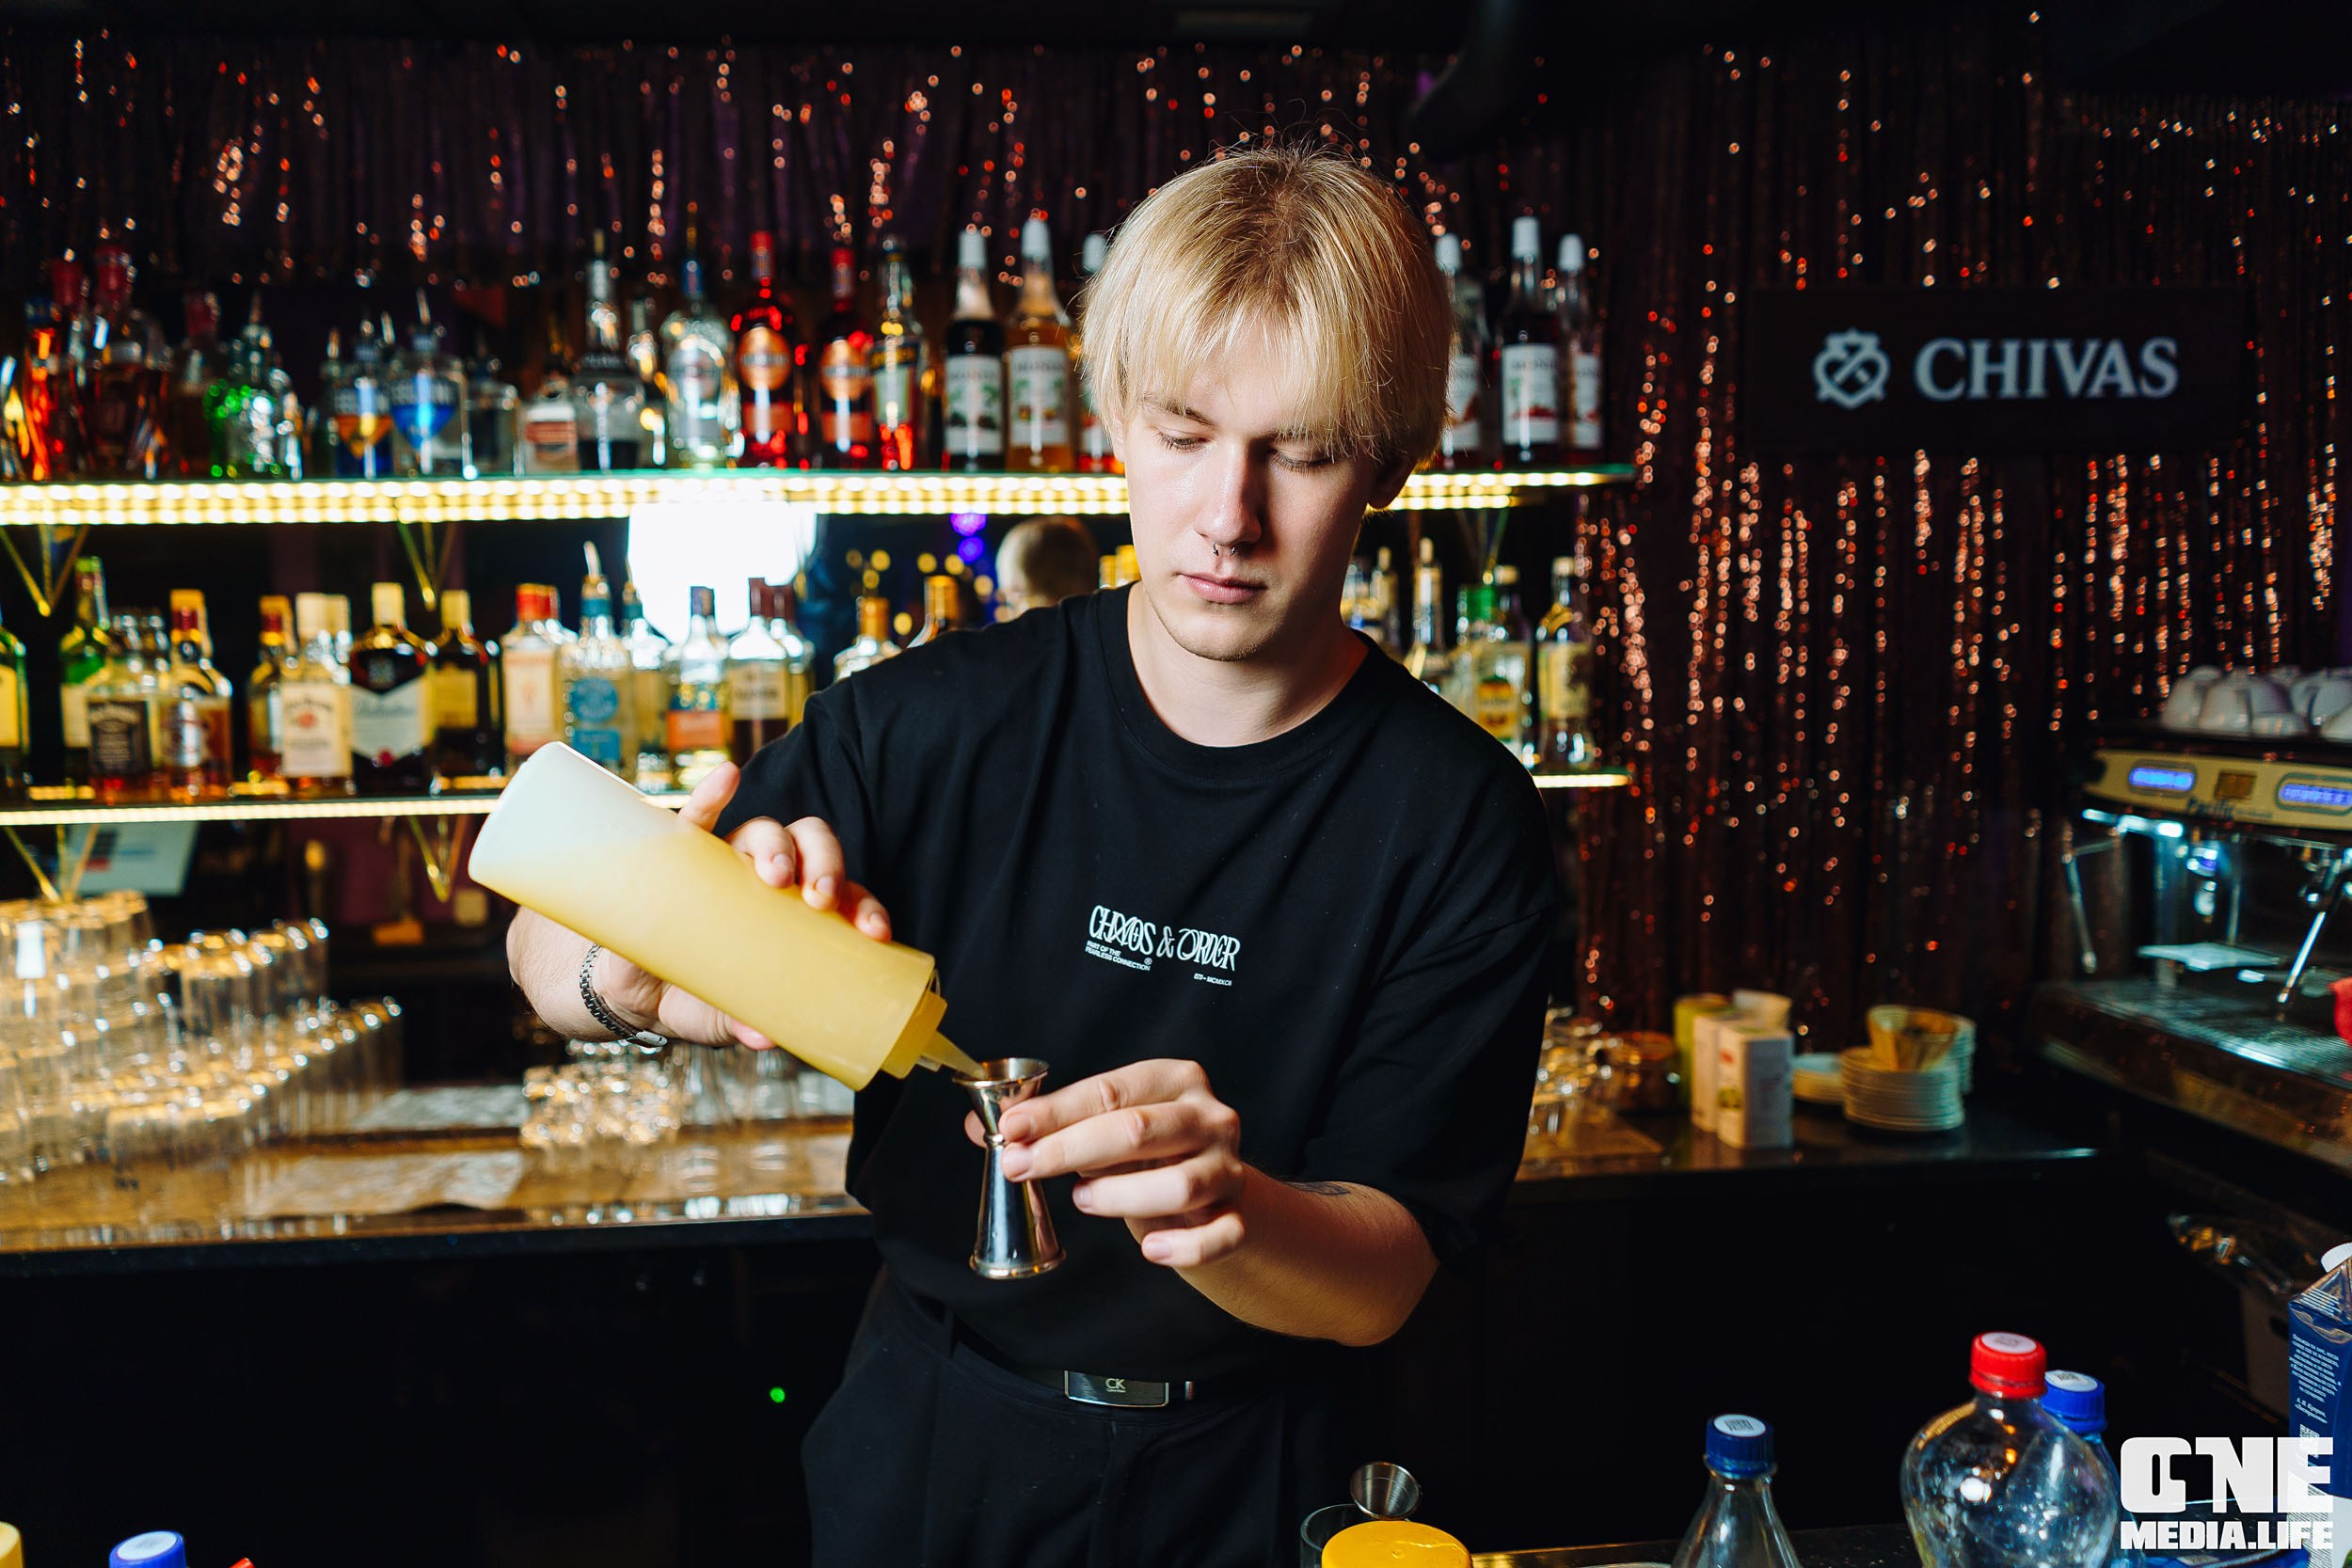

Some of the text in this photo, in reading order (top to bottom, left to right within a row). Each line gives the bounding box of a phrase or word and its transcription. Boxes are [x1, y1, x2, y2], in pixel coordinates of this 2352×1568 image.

[1914, 337, 2180, 401] CHIVAS
[1089, 904, 1241, 972] CHAOS & ORDER
[1085, 945, 1152, 971] FEARLESS CONNECTION
[1108, 947, 1121, 957] THE
[1105, 1378, 1126, 1389] CK
